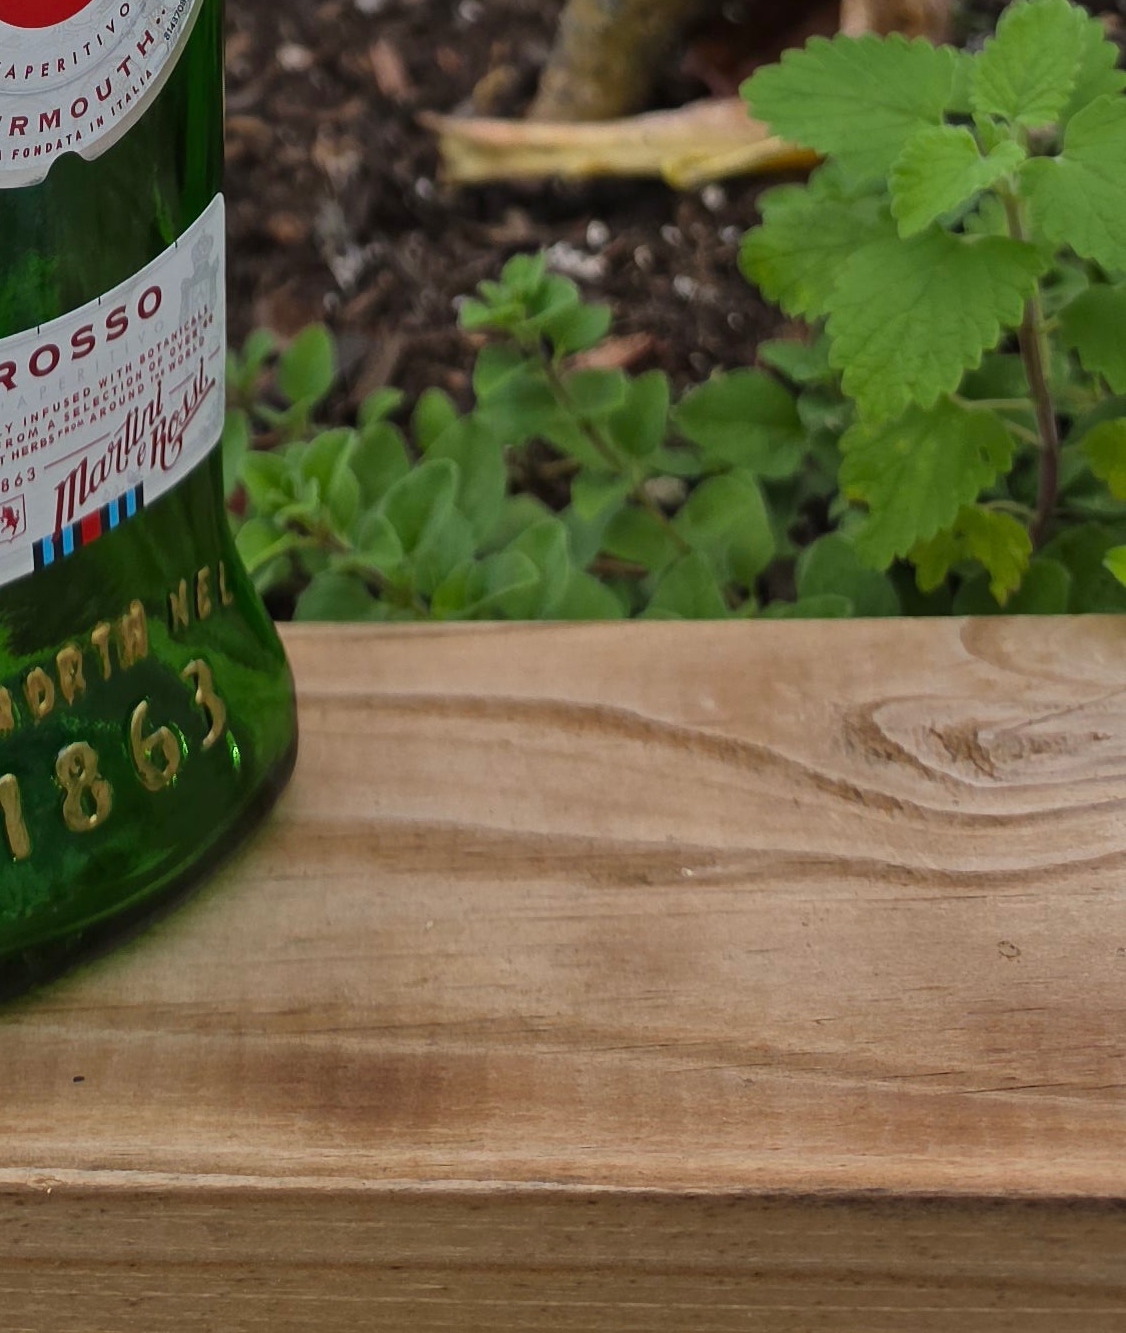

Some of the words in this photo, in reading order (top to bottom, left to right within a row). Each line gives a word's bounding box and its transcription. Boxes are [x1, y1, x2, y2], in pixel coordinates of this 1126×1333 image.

[12, 130, 82, 160] FONDATA
[90, 116, 104, 132] IN
[111, 69, 152, 116] ITALIA
[11, 433, 55, 461] HERBS
[58, 419, 84, 438] FROM
[90, 383, 144, 424] AROUND
[23, 387, 91, 426] INFUSED
[98, 362, 132, 389] WITH
[47, 419, 56, 431] A
[64, 370, 142, 422] SELECTION
[149, 356, 162, 373] OF
